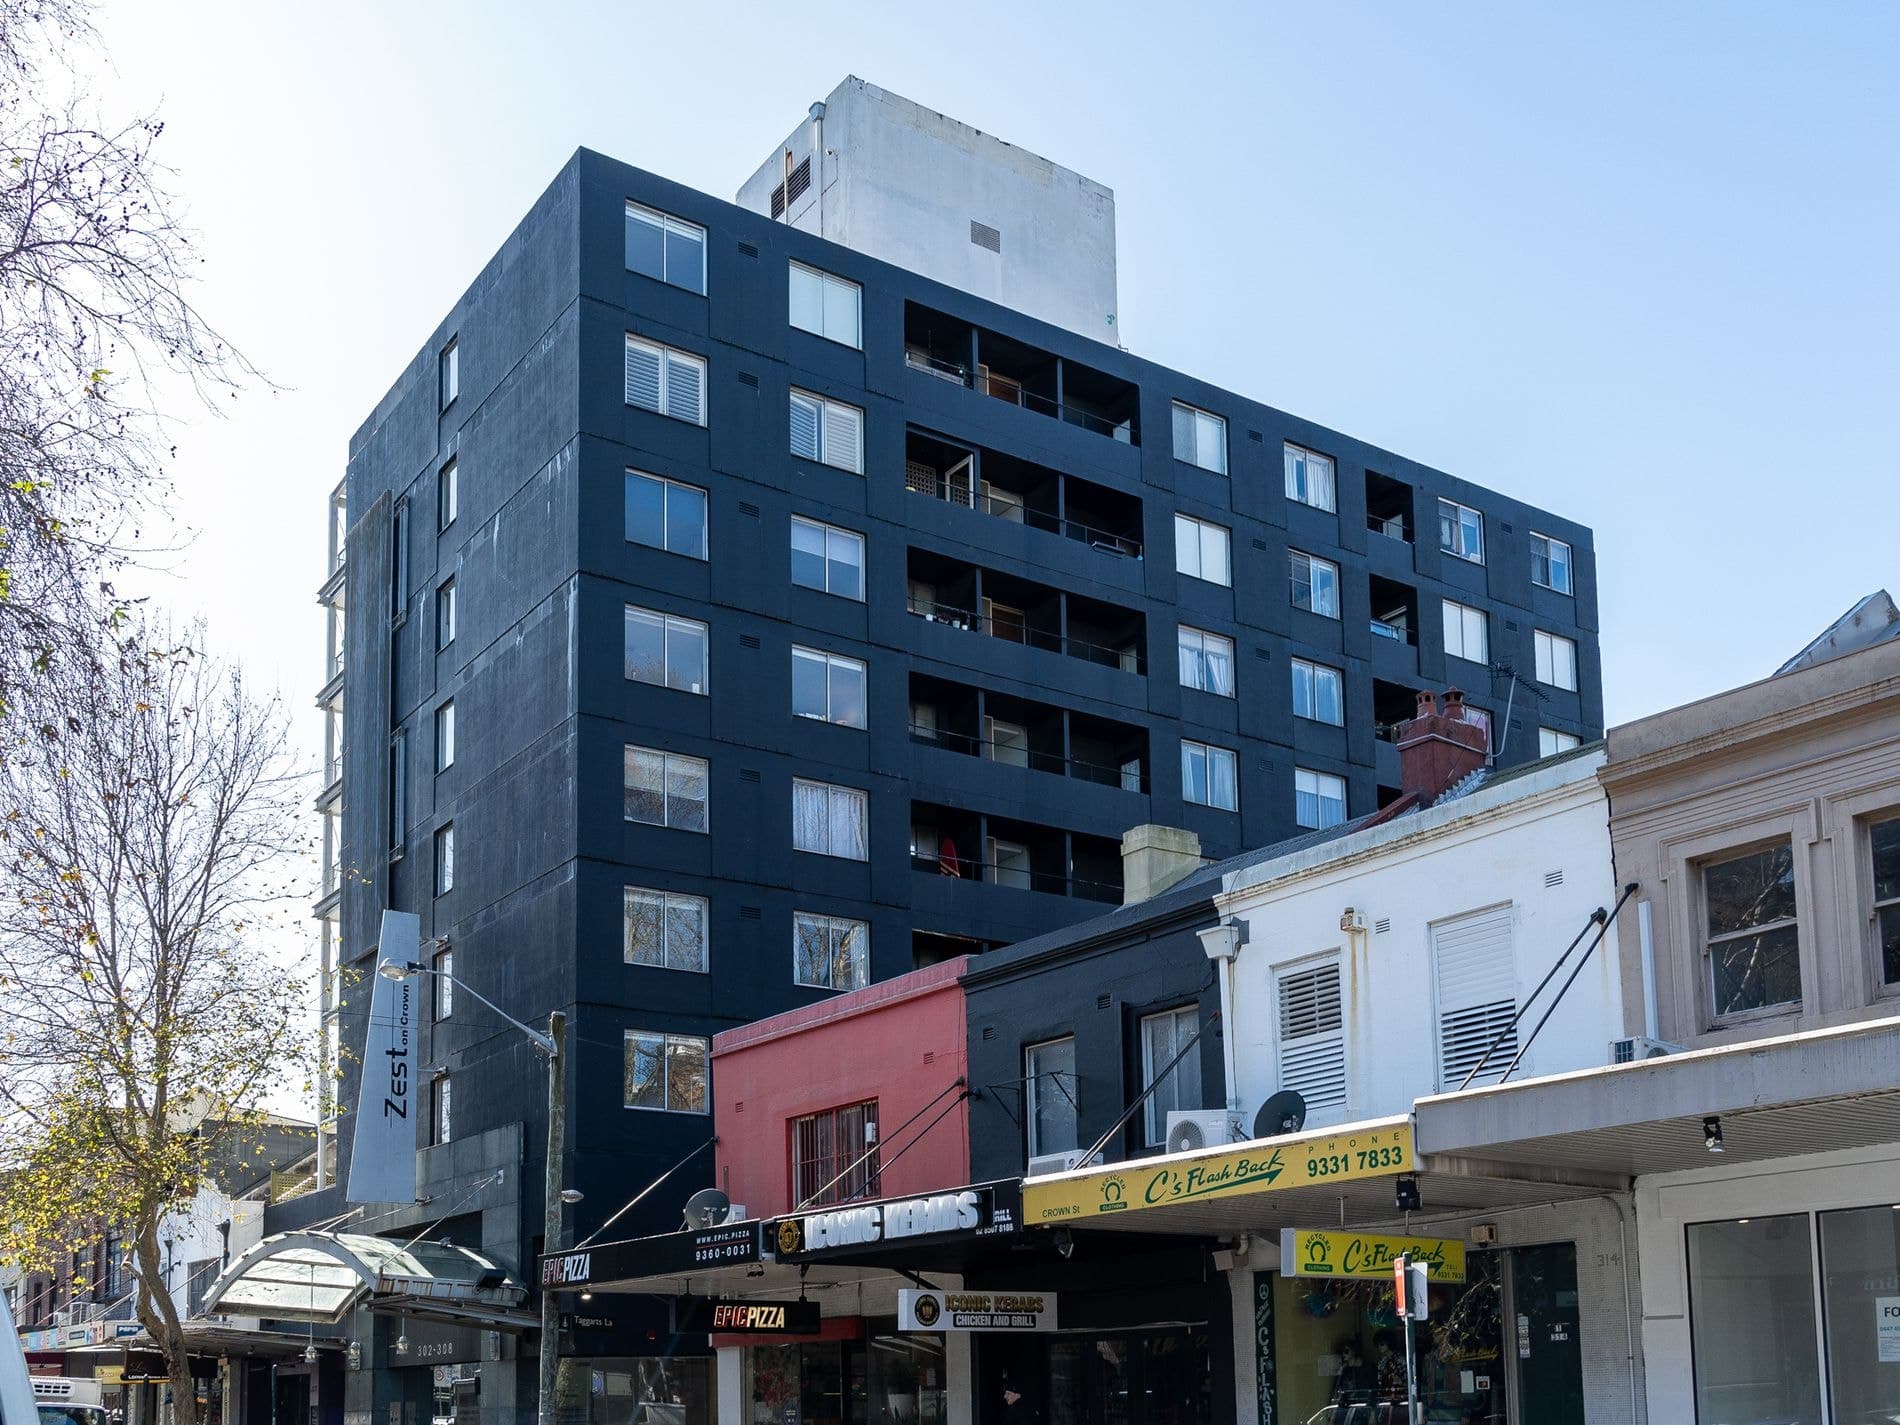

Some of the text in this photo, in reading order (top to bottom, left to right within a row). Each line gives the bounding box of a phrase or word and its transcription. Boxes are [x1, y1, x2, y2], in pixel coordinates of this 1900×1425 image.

[384, 984, 410, 1119] Zest on Crown
[1308, 1133, 1400, 1154] PHONE
[1307, 1146, 1402, 1178] 9331 7833
[1144, 1149, 1285, 1204] C's Flash Back
[804, 1206, 881, 1250] ICONIC
[883, 1191, 980, 1240] KEBABS
[1042, 1205, 1080, 1218] CROWN St
[696, 1230, 750, 1244] WWW.EPIC.PIZZA
[1305, 1232, 1332, 1251] RECYCLED
[695, 1244, 750, 1261] 9360-0031
[1343, 1239, 1373, 1273] C's
[1411, 1241, 1445, 1262] Back
[1597, 1253, 1620, 1267] 314
[944, 1294, 992, 1313] ICONIC
[993, 1295, 1045, 1314] KEBABS
[574, 1315, 613, 1327] Taggarts La
[955, 1314, 1034, 1327] CHICKEN AND GRILL
[416, 1342, 453, 1357] 302-308
